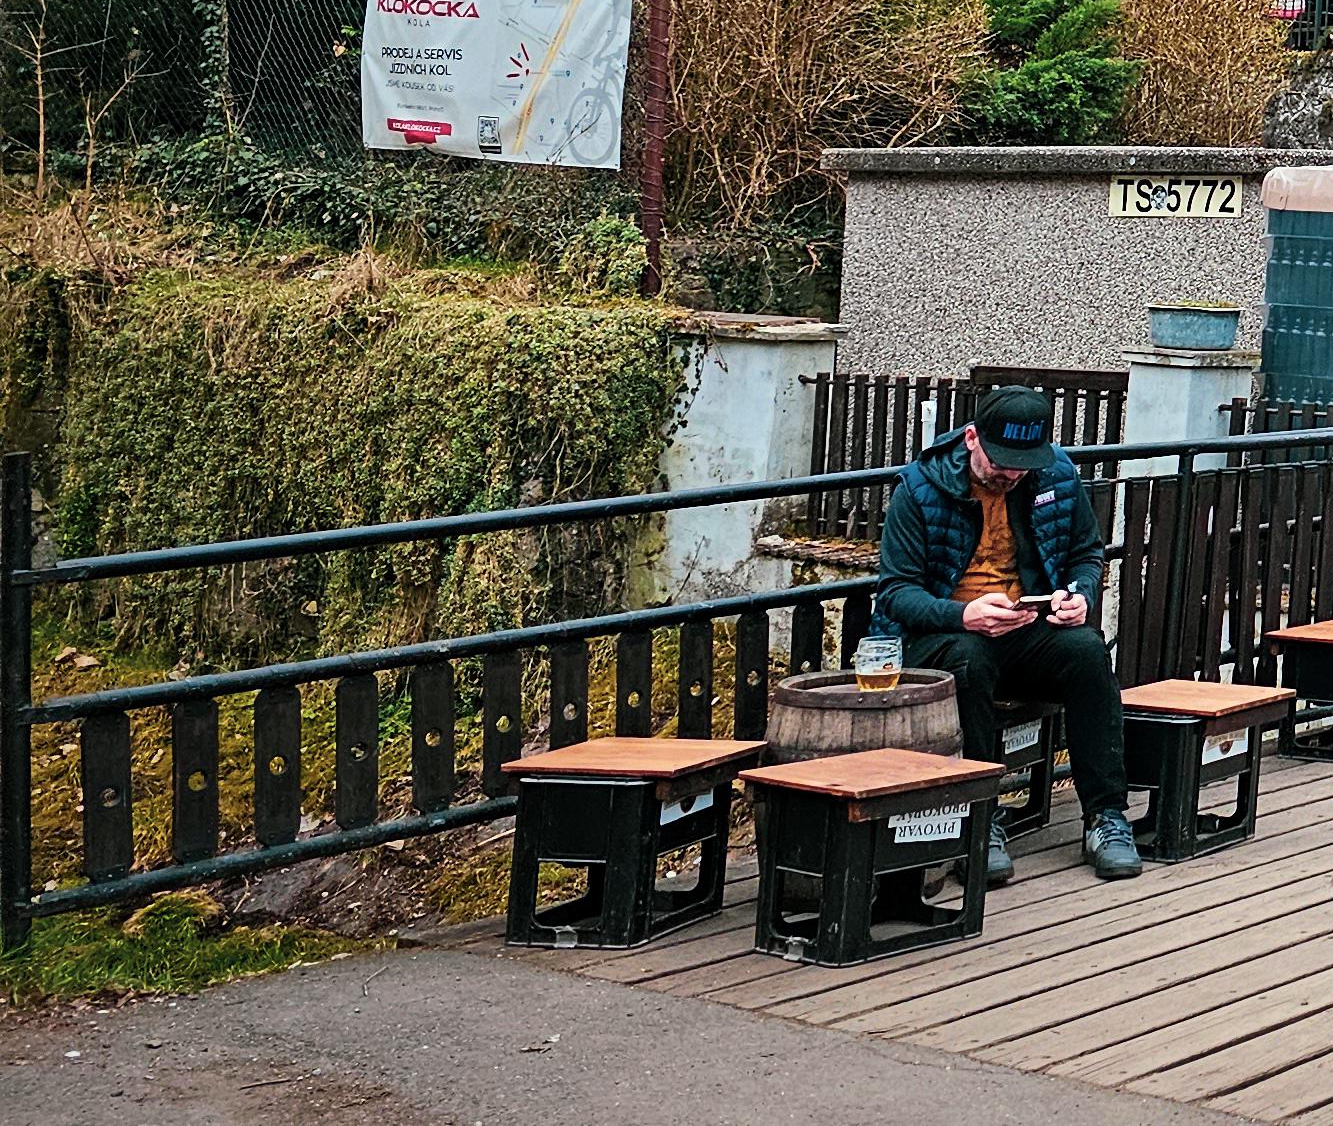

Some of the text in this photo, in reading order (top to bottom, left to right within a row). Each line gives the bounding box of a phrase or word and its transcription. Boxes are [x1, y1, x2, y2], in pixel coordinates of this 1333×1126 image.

[407, 19, 431, 27] KOLA
[382, 47, 463, 61] PRODEJ A SERVIS
[389, 59, 452, 76] JÍZDNÍCH KOL
[898, 821, 956, 838] PIVOVAR
